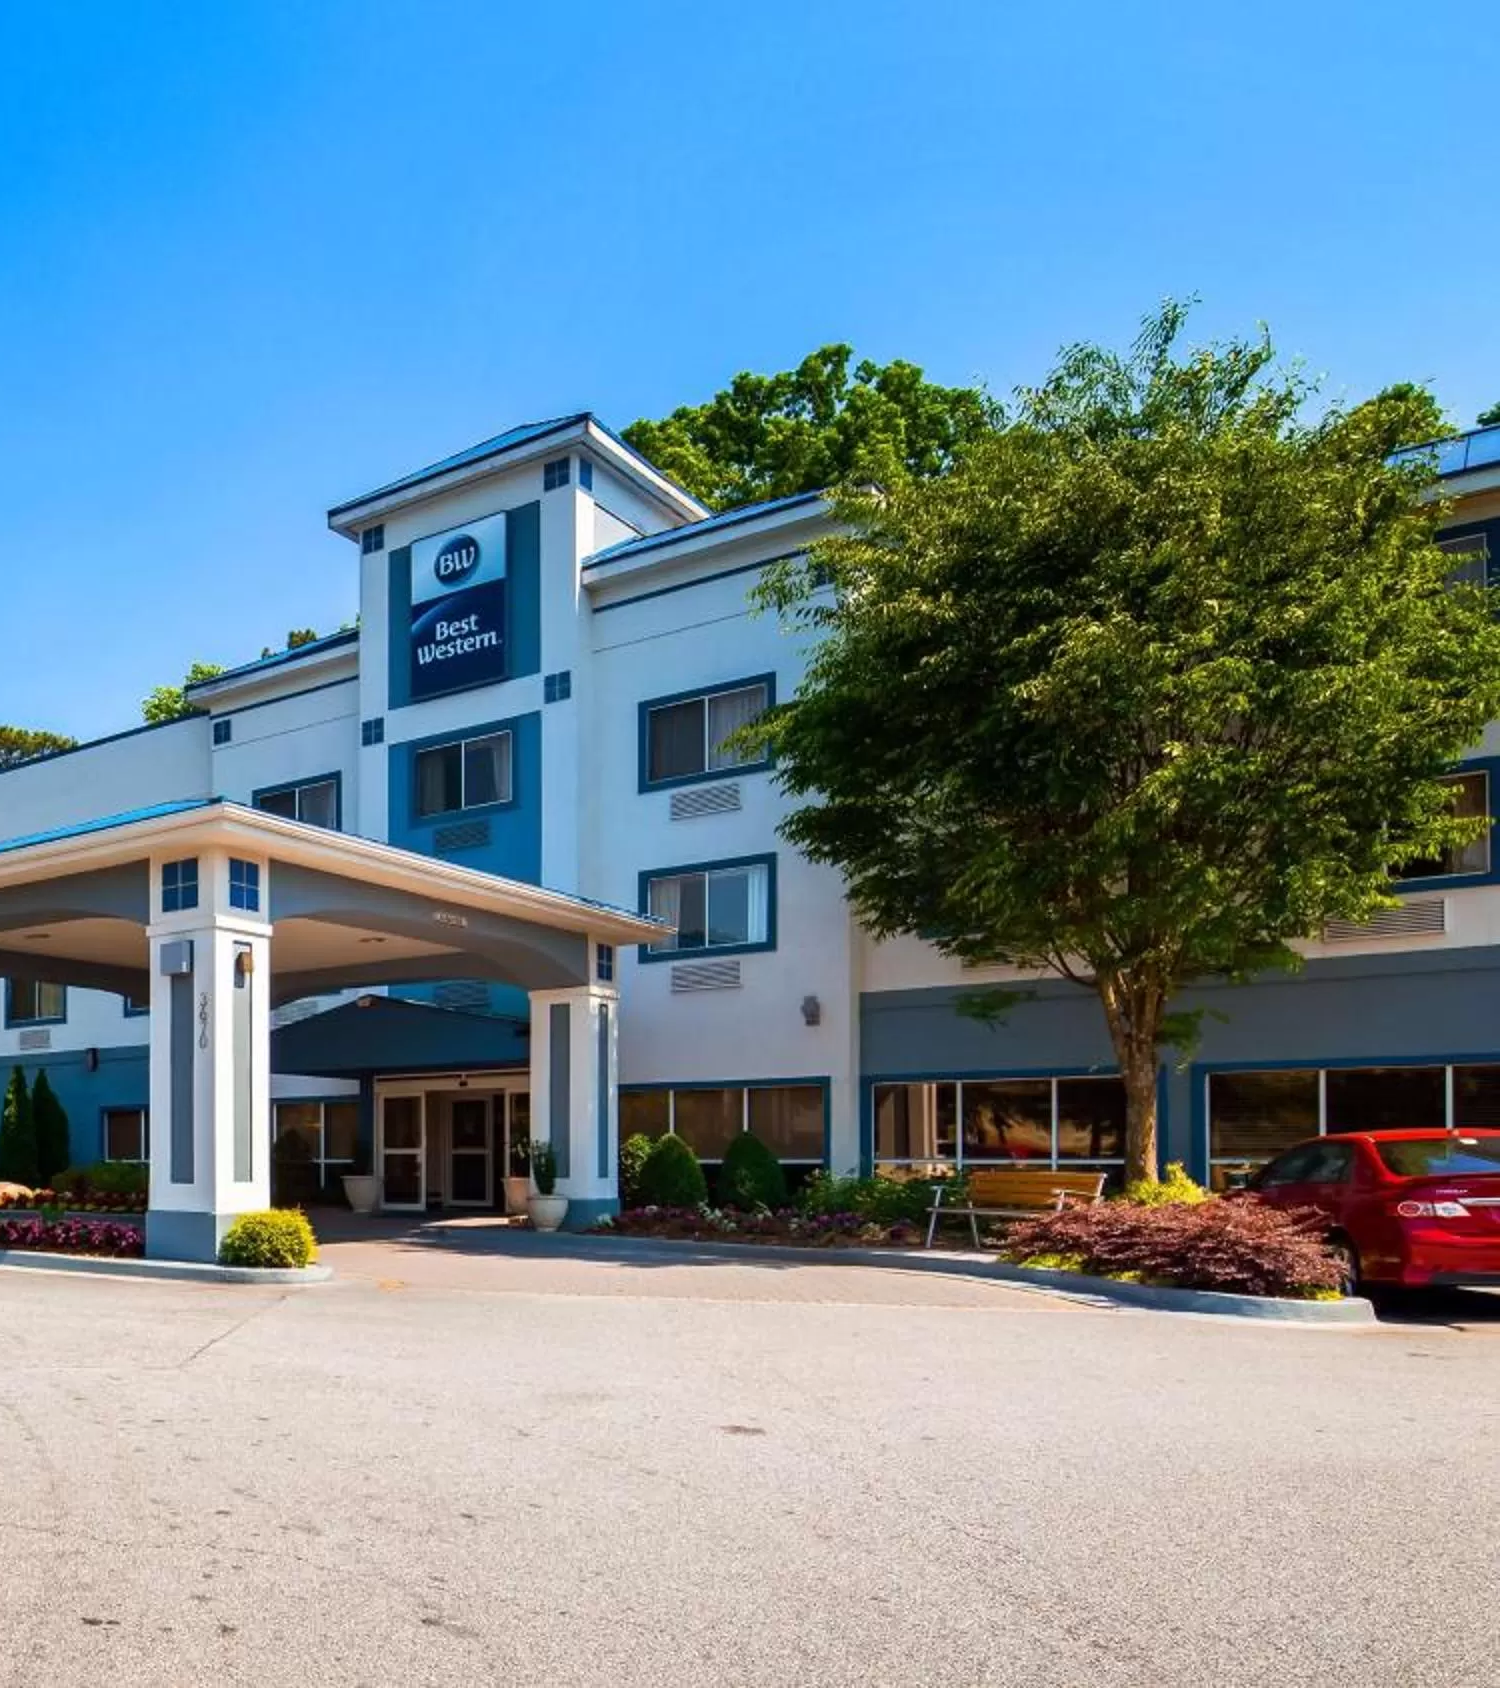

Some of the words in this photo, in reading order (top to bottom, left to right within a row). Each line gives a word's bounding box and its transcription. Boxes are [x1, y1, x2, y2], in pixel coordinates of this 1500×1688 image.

[439, 546, 475, 576] BW
[435, 613, 479, 641] Best
[417, 630, 498, 665] Western
